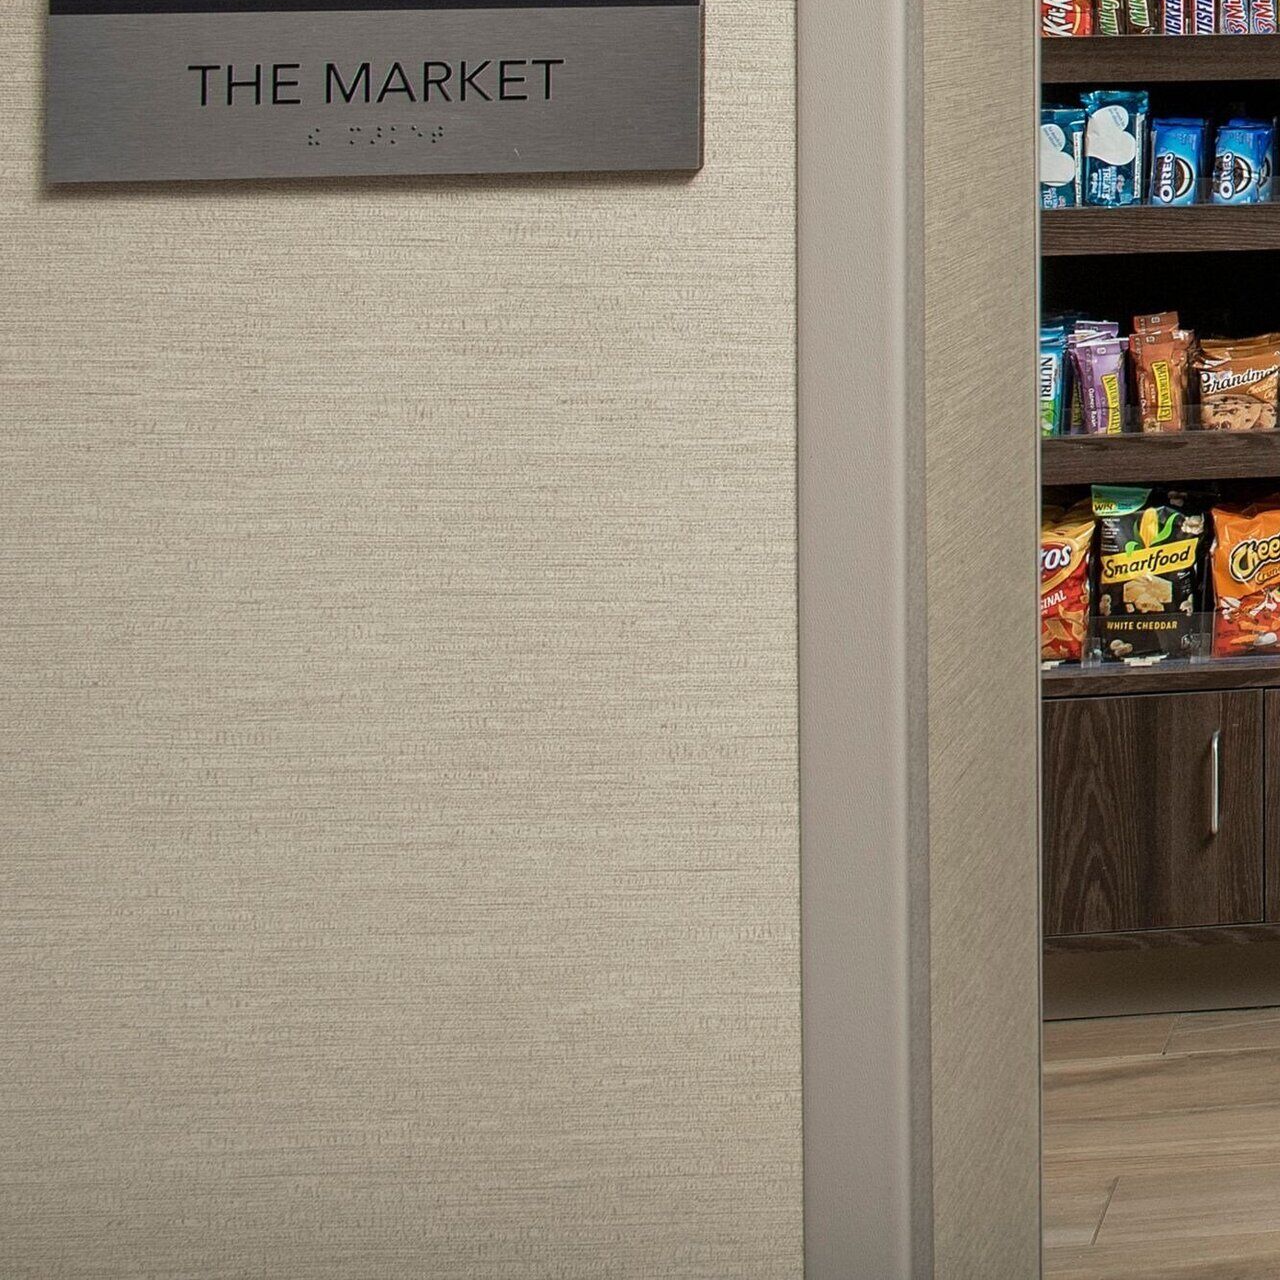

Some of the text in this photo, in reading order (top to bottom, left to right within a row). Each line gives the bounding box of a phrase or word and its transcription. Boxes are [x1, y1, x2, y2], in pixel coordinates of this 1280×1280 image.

[187, 58, 564, 106] THE MARKET
[1160, 152, 1175, 203] OREO
[1220, 152, 1234, 200] OREO
[1103, 545, 1191, 578] Smartfood
[1106, 620, 1178, 631] WHITE CHEDDAR
